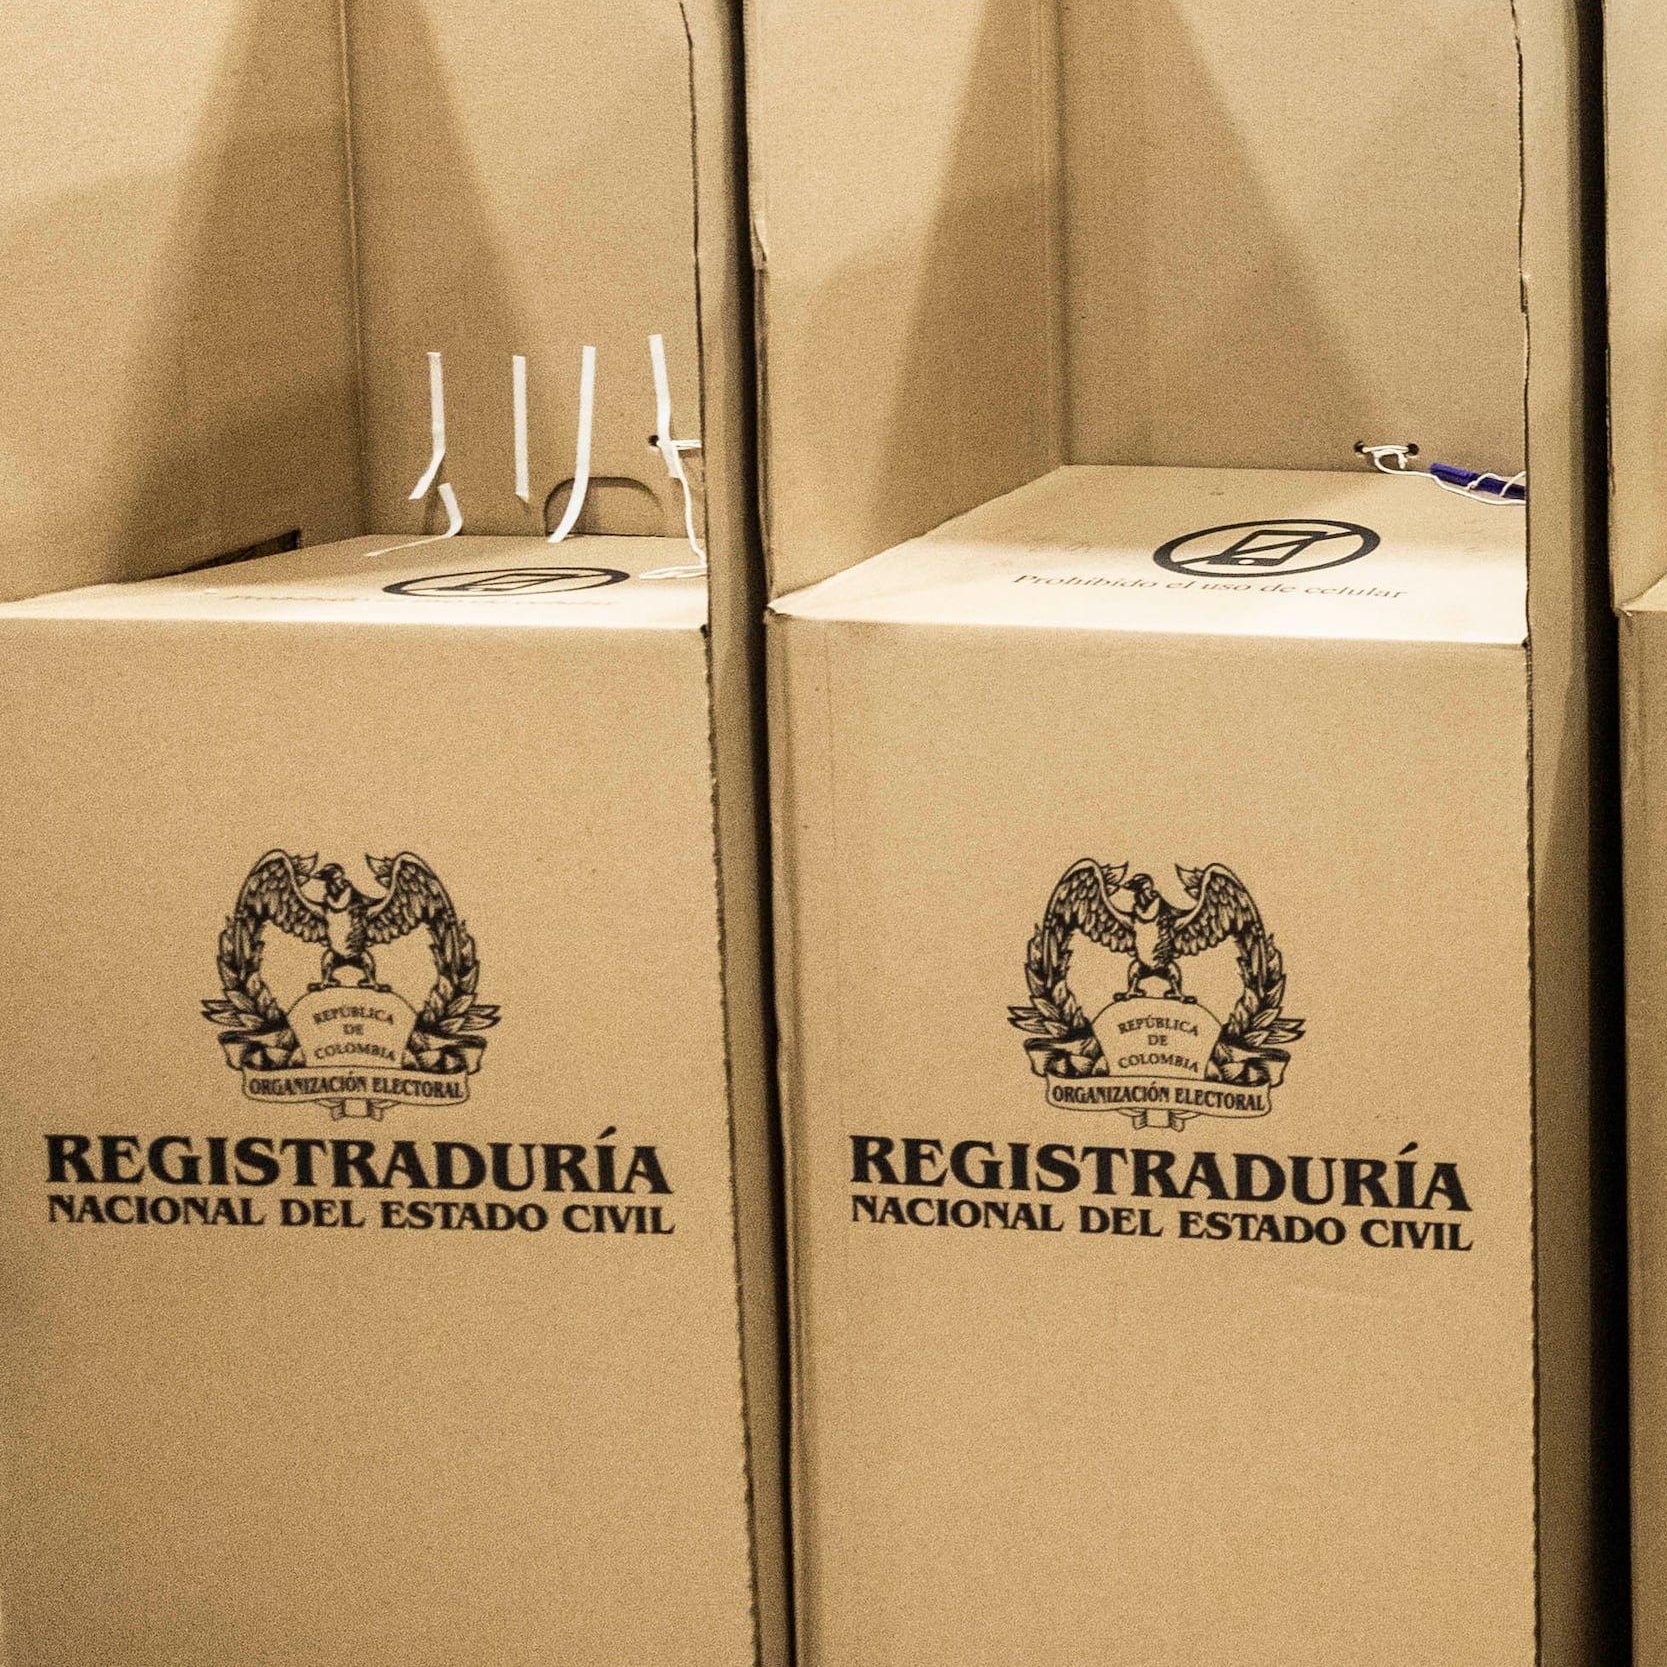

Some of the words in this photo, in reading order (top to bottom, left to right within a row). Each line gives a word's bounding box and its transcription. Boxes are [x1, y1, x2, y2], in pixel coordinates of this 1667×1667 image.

[1013, 574, 1158, 588] Prohibido
[1166, 580, 1197, 589] el
[1201, 583, 1252, 591] uso
[1260, 583, 1297, 593] de
[1304, 586, 1408, 598] celular
[1117, 1015, 1199, 1036] REPÚBLICA
[1148, 1034, 1168, 1046] DE
[1118, 1053, 1199, 1073] COLOMBIA
[1052, 1081, 1170, 1104] ORGANIZACIÓN
[1175, 1087, 1265, 1111] ELECTORAL
[45, 1127, 672, 1195] REGISTRADURÍA
[848, 1134, 1473, 1212] REGISTRADURÍA
[48, 1194, 264, 1226] NACIONAL
[280, 1198, 365, 1229] DEL
[380, 1200, 548, 1232] ESTADO
[562, 1204, 674, 1235] CIVIL
[851, 1195, 1065, 1232] NACIONAL
[1079, 1206, 1164, 1237] DEL
[1180, 1209, 1346, 1245] ESTADO
[1360, 1218, 1474, 1251] CIVIL
